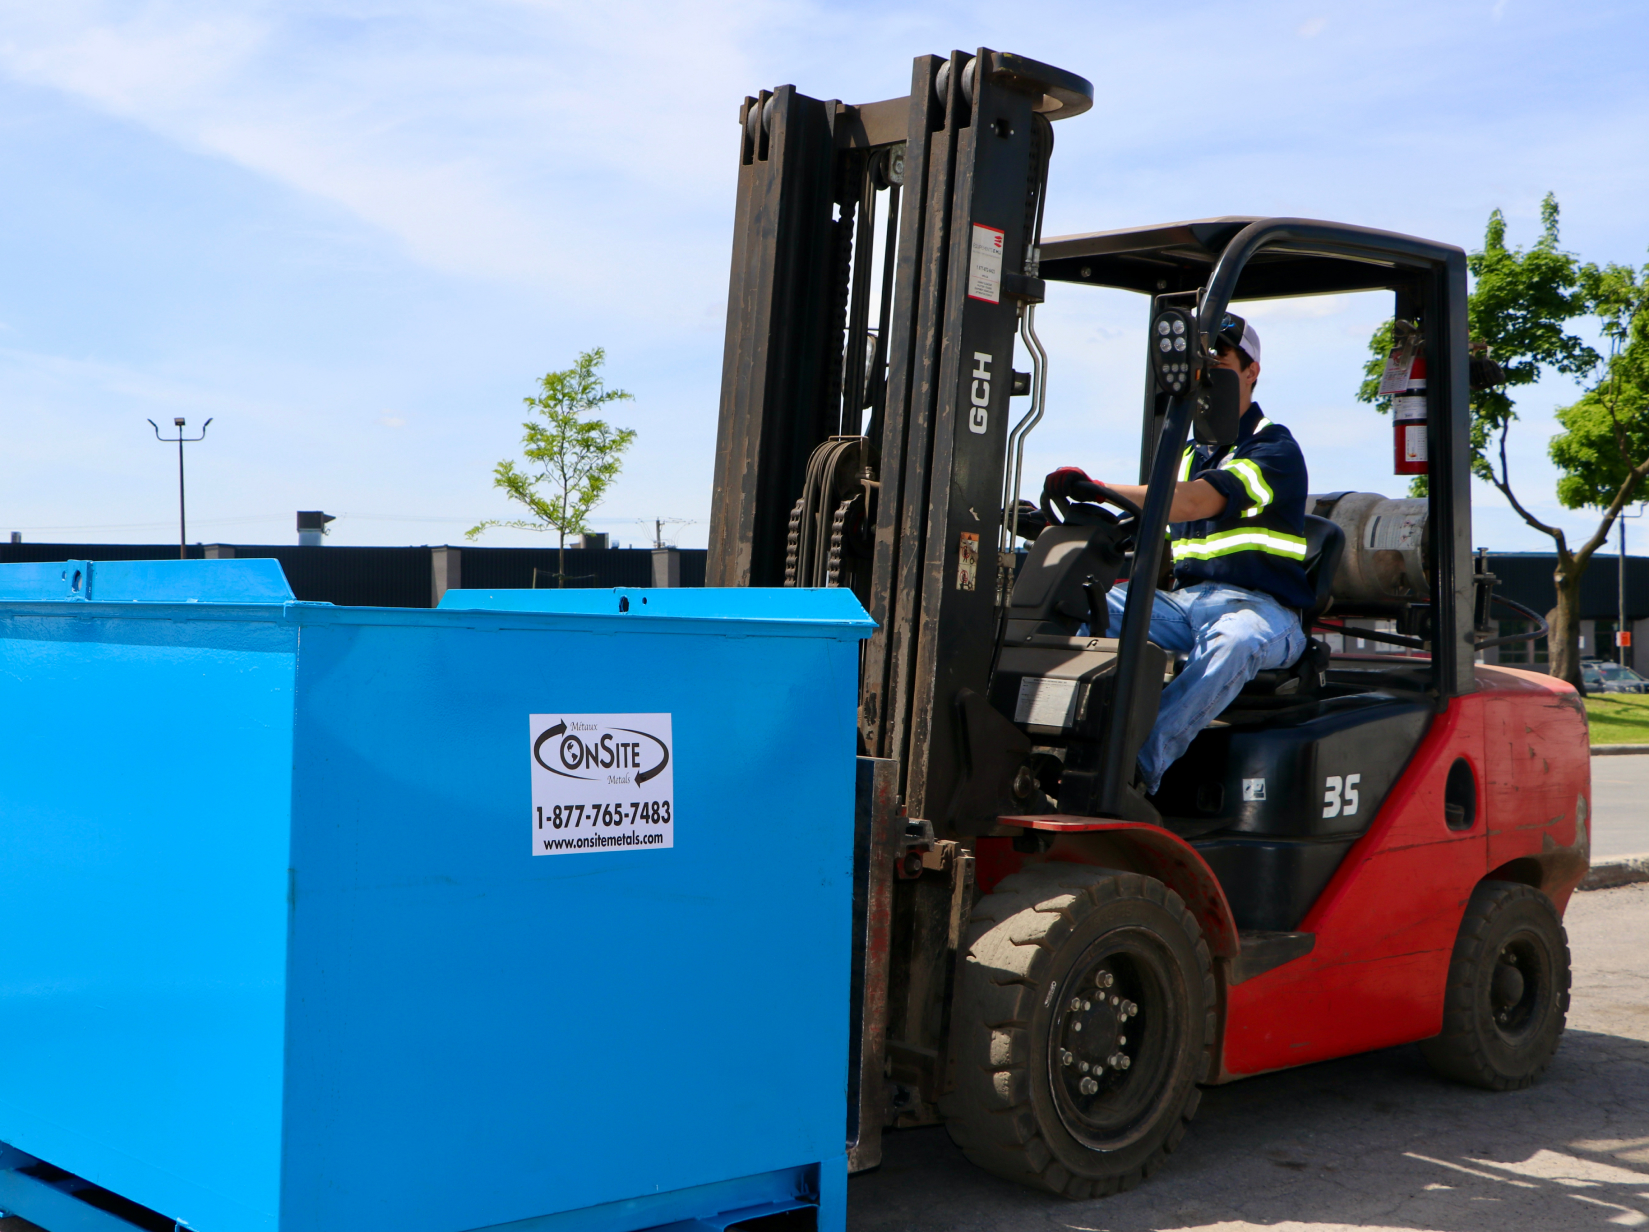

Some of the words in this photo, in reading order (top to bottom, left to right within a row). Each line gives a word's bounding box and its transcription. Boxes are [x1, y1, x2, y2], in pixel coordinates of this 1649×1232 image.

[968, 351, 993, 435] GCH
[570, 721, 598, 732] Métaux
[607, 772, 631, 785] Metals
[1322, 773, 1361, 819] 35
[536, 800, 671, 829] 1-877-765-7483
[543, 829, 663, 850] www.onsitemetals.com
